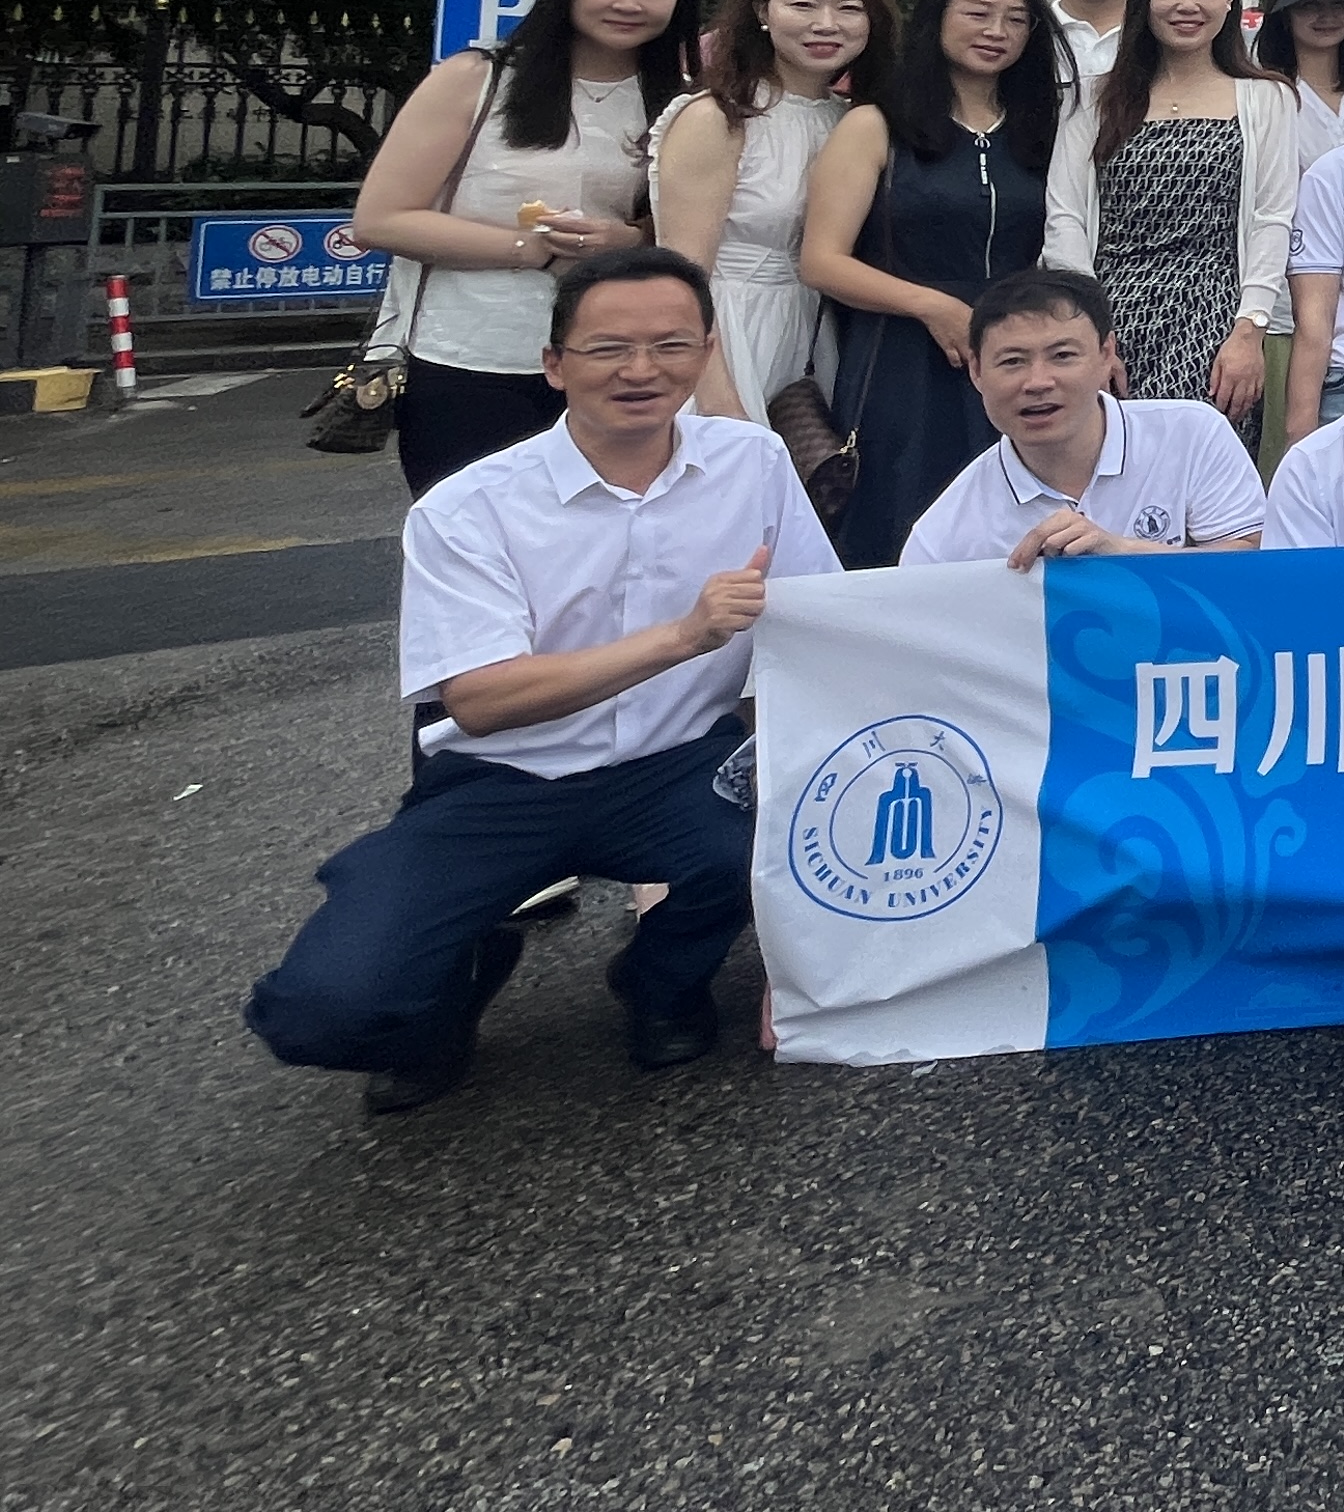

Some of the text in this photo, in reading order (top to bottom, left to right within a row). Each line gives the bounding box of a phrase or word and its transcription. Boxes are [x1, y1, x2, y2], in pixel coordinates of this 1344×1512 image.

[803, 809, 993, 908] SICHUAN UNIVERSITY
[884, 869, 924, 882] 1896
